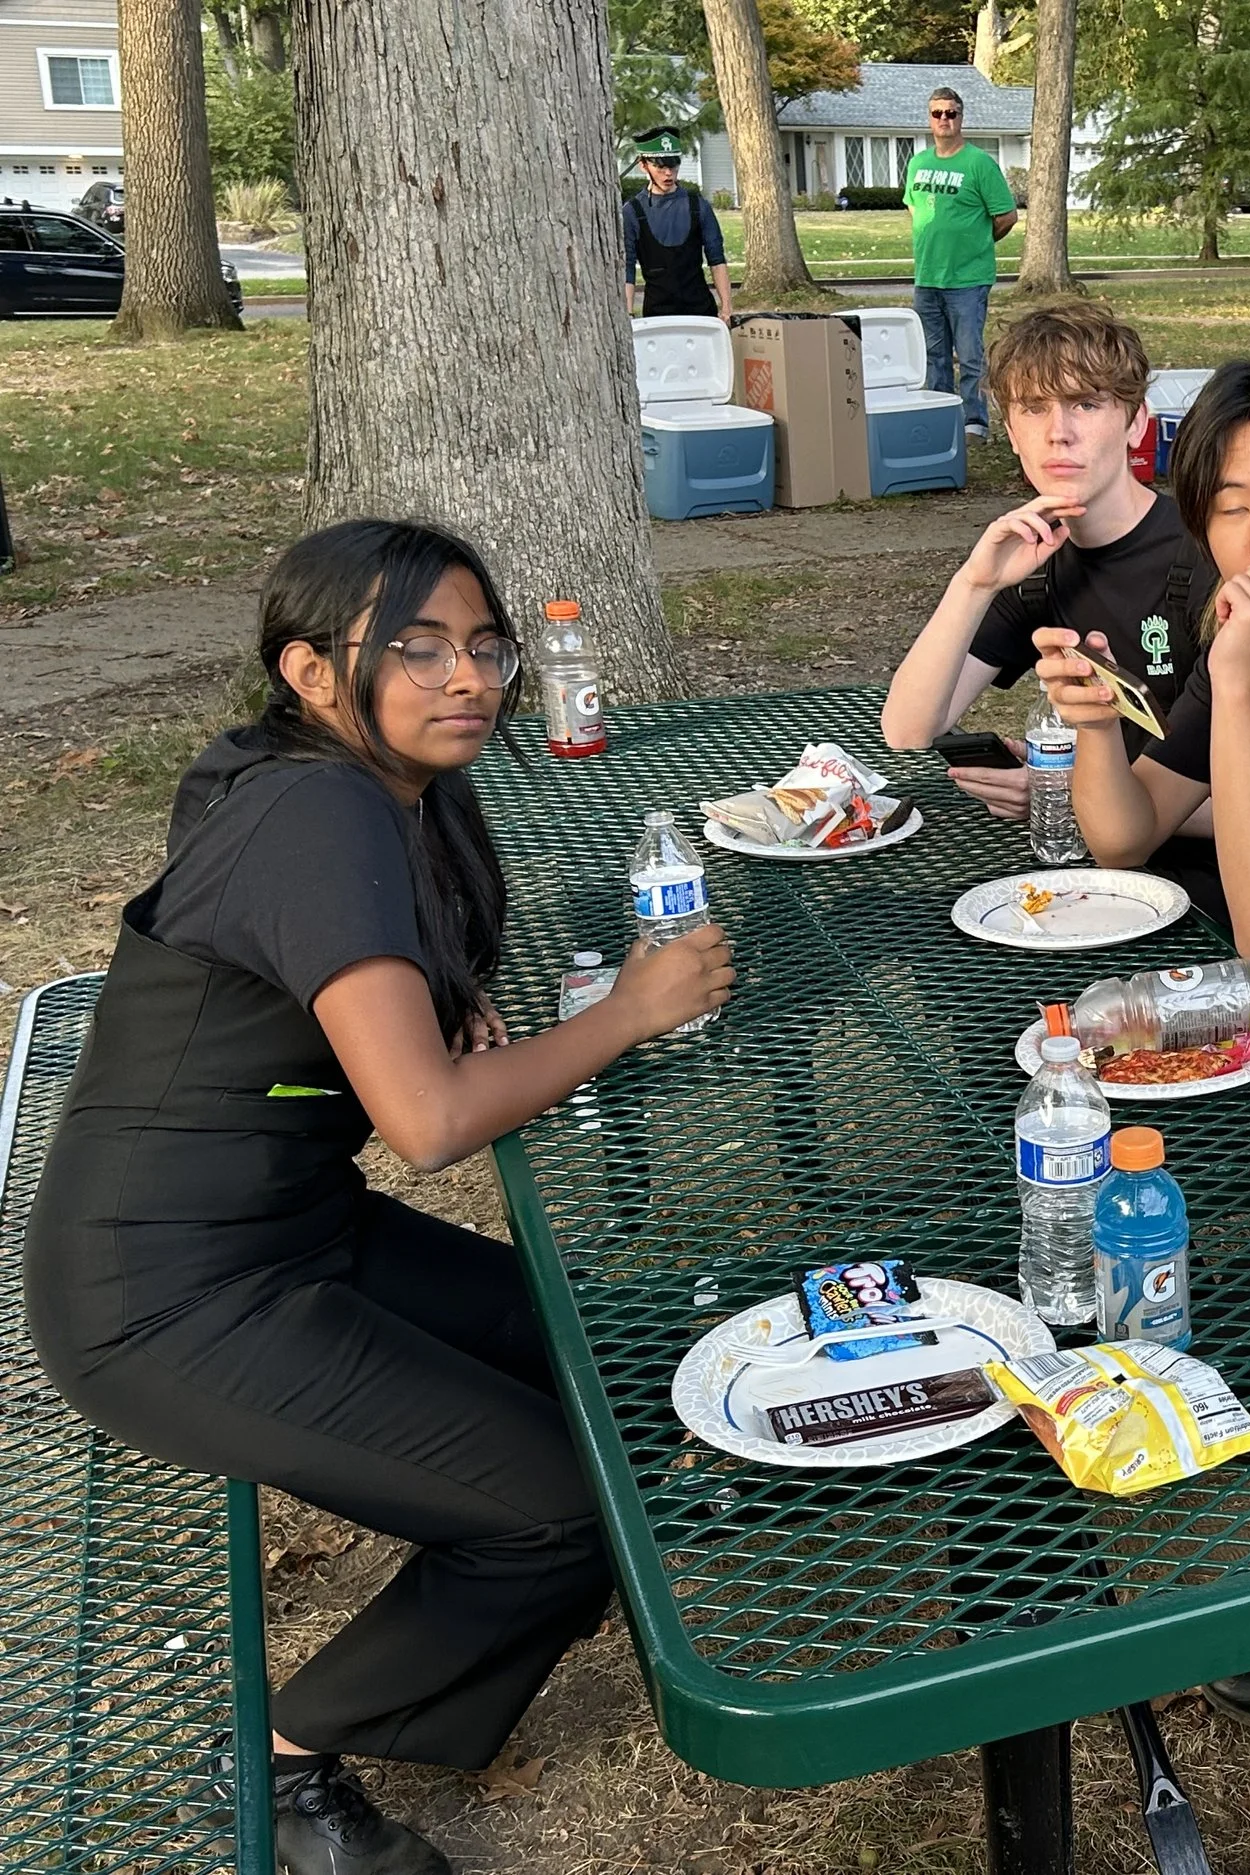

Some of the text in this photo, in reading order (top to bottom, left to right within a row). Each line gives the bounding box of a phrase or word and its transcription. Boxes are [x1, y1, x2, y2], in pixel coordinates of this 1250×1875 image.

[913, 183, 959, 194] BAND
[1146, 663, 1174, 676] BAN
[575, 684, 600, 716] G
[1143, 1261, 1176, 1304] G
[819, 1279, 856, 1316] Crawler
[779, 1382, 929, 1431] HERSHEY'S
[852, 1403, 932, 1424] milk chocolate
[1192, 1402, 1209, 1413] 160
[1203, 1431, 1223, 1441] Facts
[1121, 1453, 1145, 1477] CRISPY
